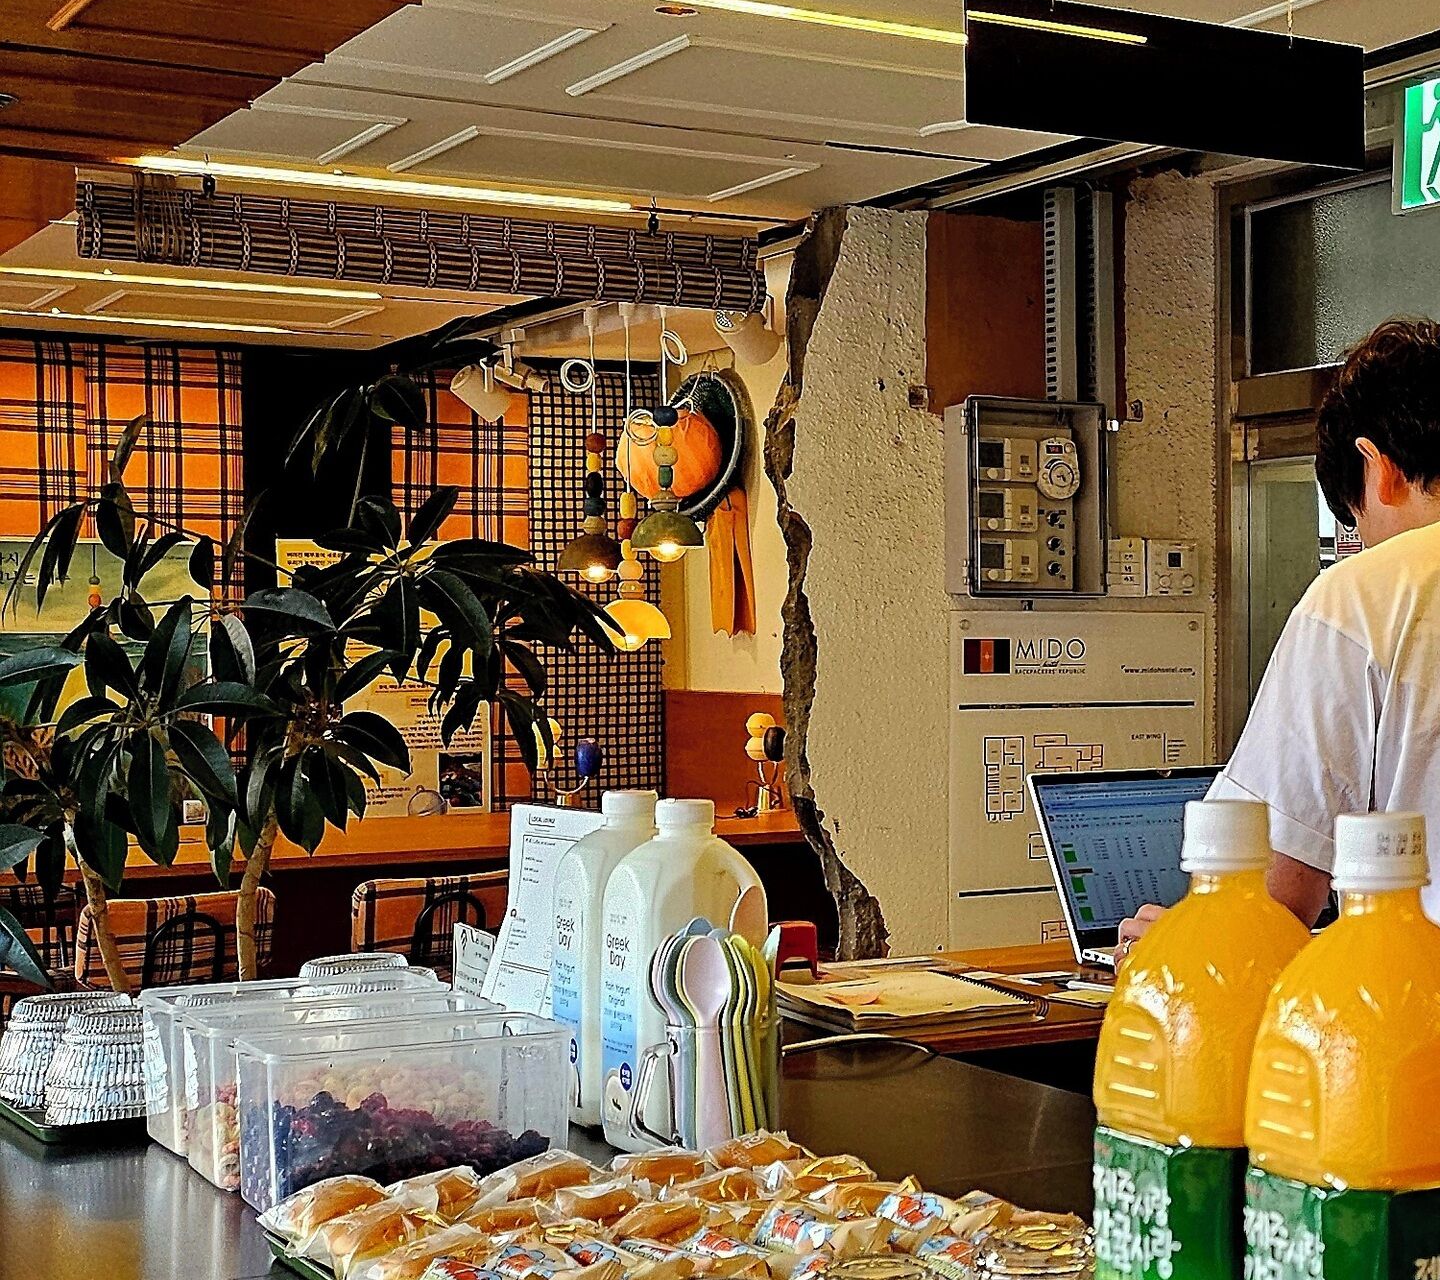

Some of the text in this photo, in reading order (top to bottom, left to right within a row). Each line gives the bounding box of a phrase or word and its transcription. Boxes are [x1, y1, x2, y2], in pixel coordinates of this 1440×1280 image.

[1016, 639, 1086, 660] MIDO
[556, 915, 575, 933] Greek
[558, 931, 572, 951] Day
[606, 933, 630, 953] Greek
[609, 951, 626, 971] Day
